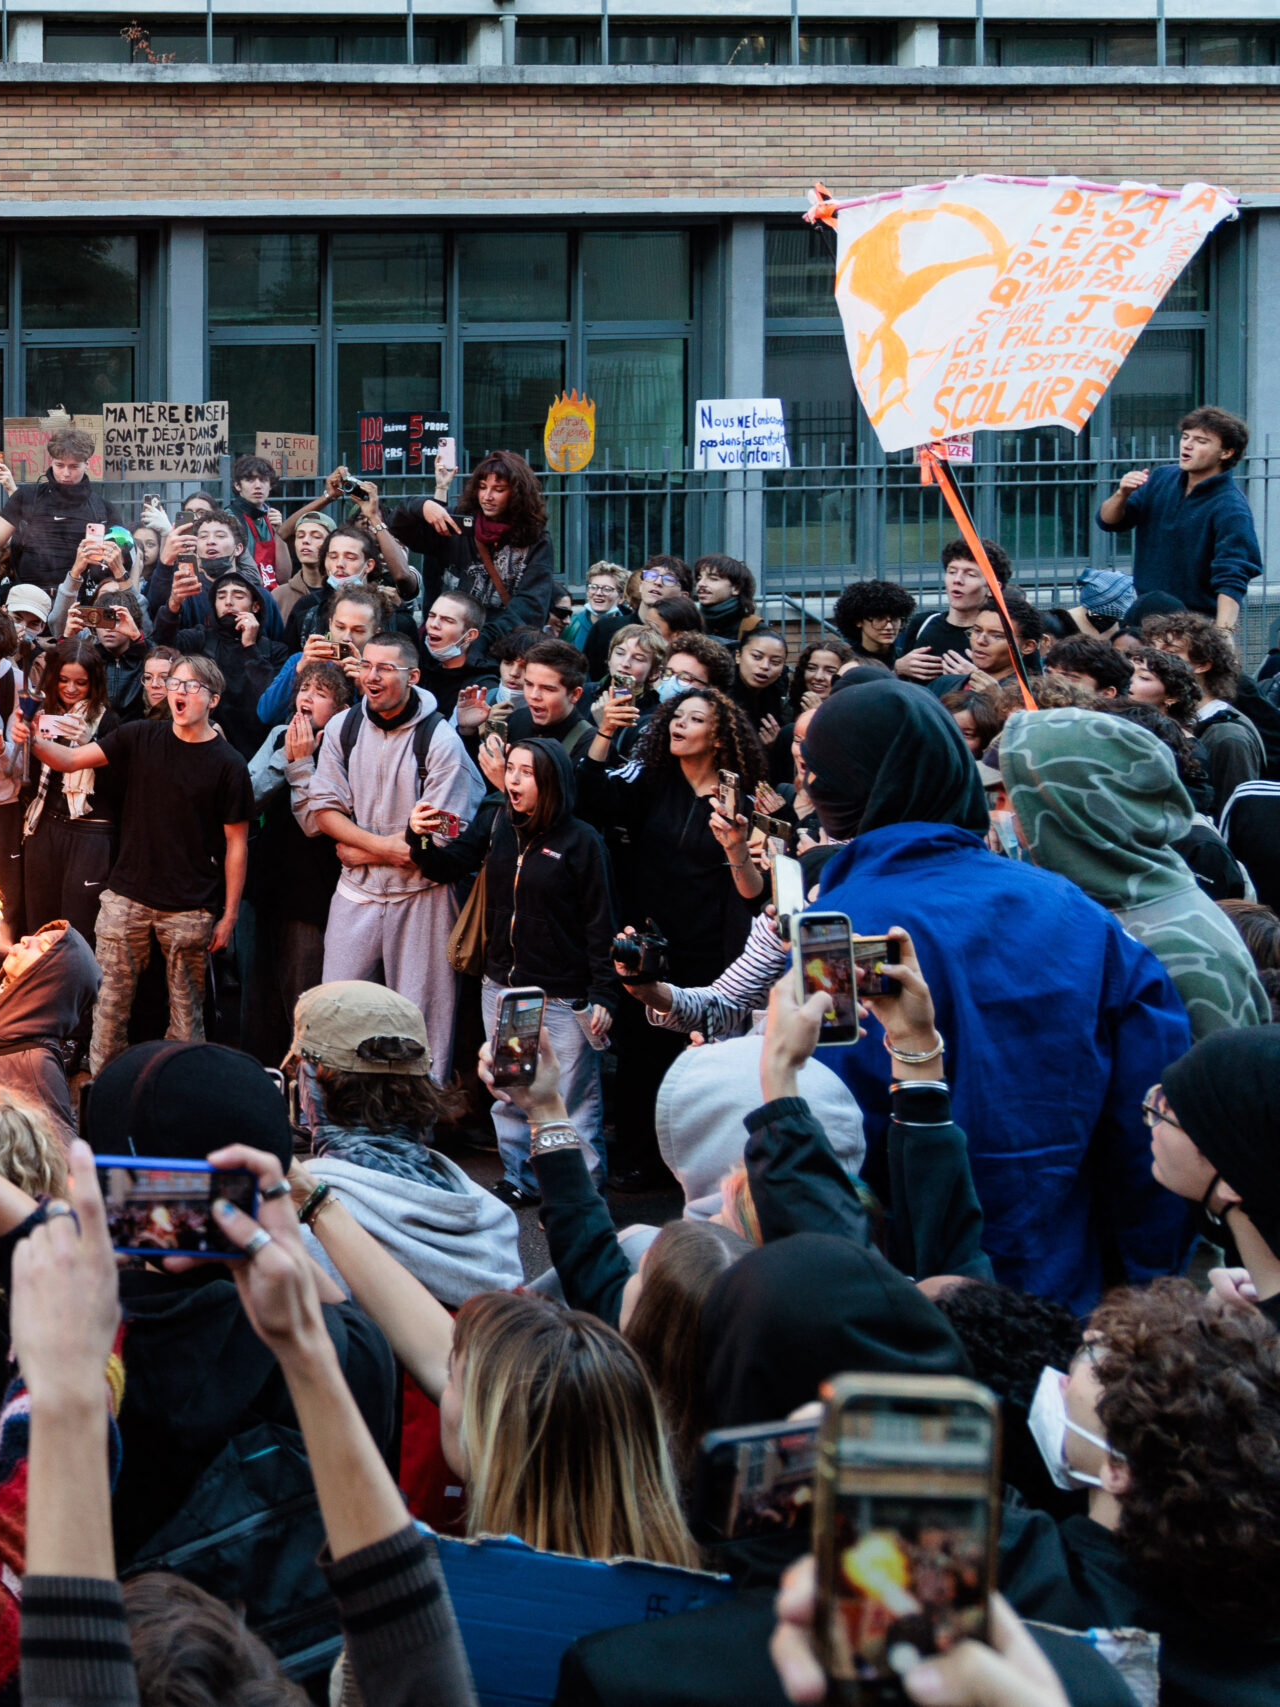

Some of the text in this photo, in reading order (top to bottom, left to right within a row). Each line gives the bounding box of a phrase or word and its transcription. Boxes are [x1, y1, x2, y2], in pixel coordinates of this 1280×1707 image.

[950, 330, 988, 360] LA
[941, 358, 988, 386] PAS
[989, 354, 1016, 377] LE
[105, 406, 127, 422] MA
[701, 405, 735, 428] Nous
[152, 423, 186, 442] DÉJÀ
[189, 424, 218, 441] DANS
[361, 416, 383, 442] 100
[409, 415, 424, 439] 5
[105, 436, 229, 458] DES RUINES POUR UNE
[276, 437, 291, 448] DE
[293, 438, 315, 450] FRIC
[700, 440, 718, 455] pas
[719, 432, 741, 446] dans
[742, 430, 752, 446] la
[160, 459, 173, 471] IL
[173, 459, 181, 470] Y
[181, 459, 189, 473] A
[190, 459, 200, 473] 20
[271, 459, 314, 472] BLIC!
[361, 443, 383, 471] 100
[384, 448, 403, 458] CRS
[409, 443, 422, 466] 5
